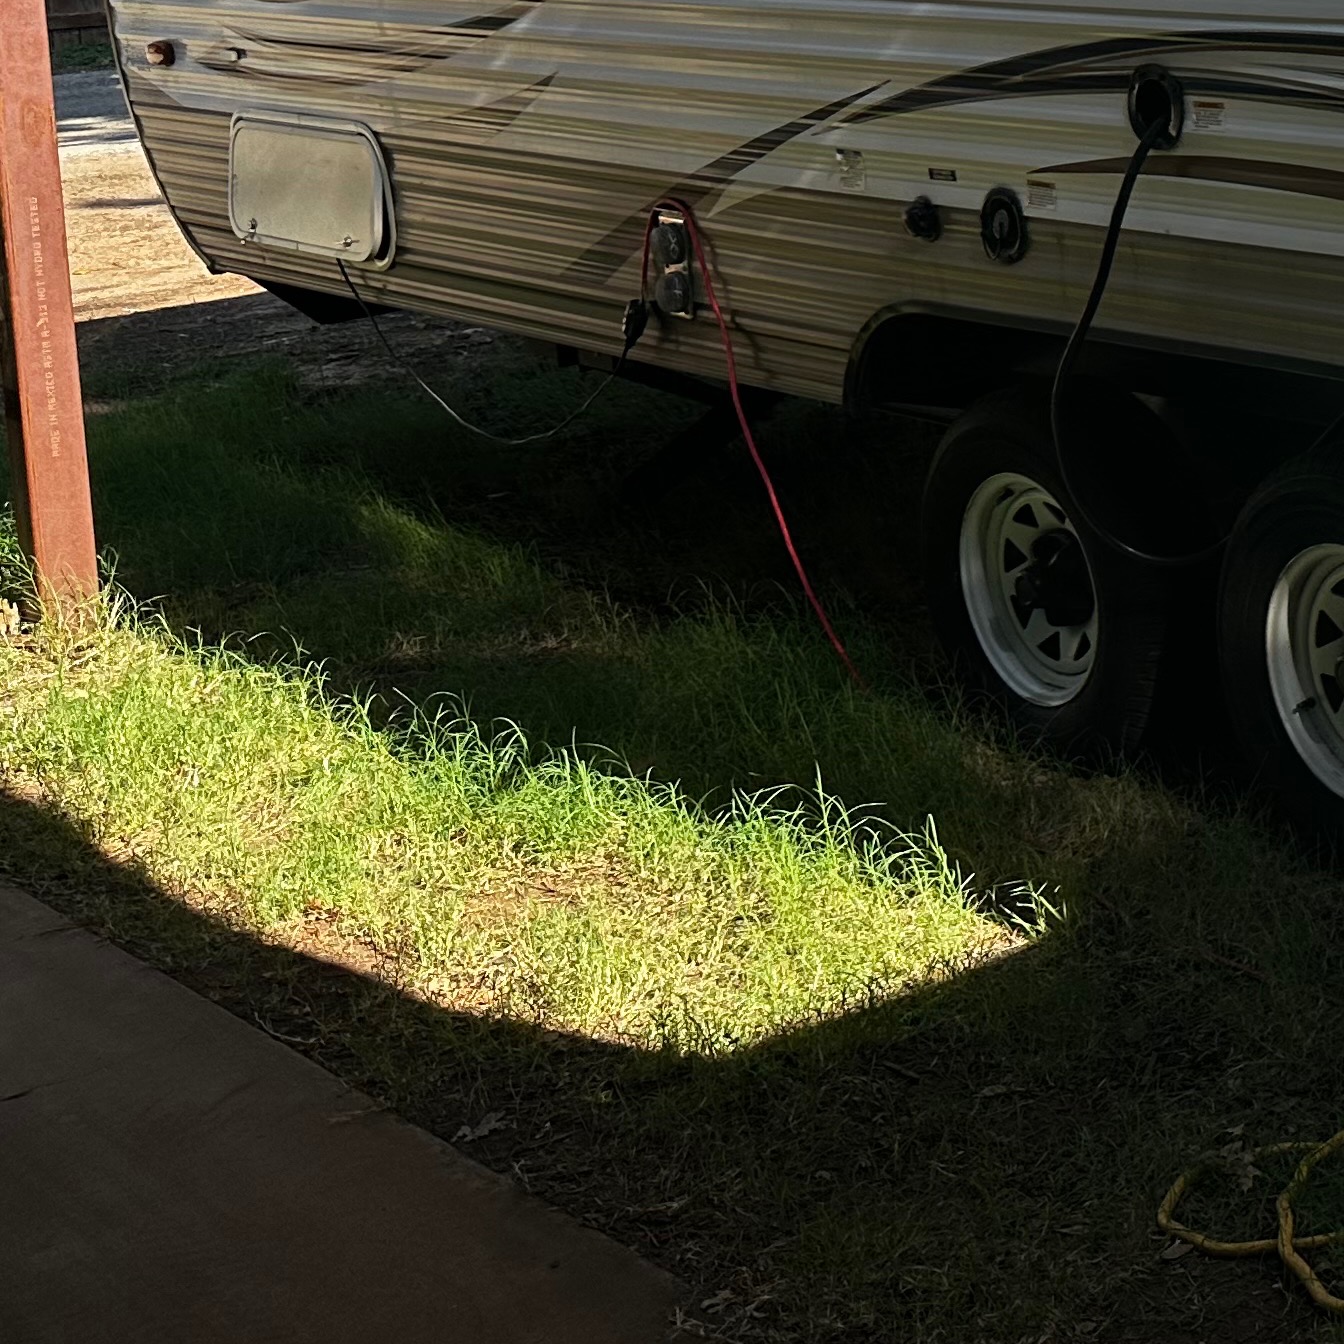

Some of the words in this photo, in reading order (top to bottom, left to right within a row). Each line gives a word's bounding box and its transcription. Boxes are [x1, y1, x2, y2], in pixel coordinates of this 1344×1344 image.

[29, 195, 41, 237] TESTED
[32, 240, 44, 276] HYDRO
[36, 280, 47, 300] NOT
[45, 370, 57, 410] MEXICO
[48, 413, 58, 425] IN
[50, 429, 61, 457] MADE
